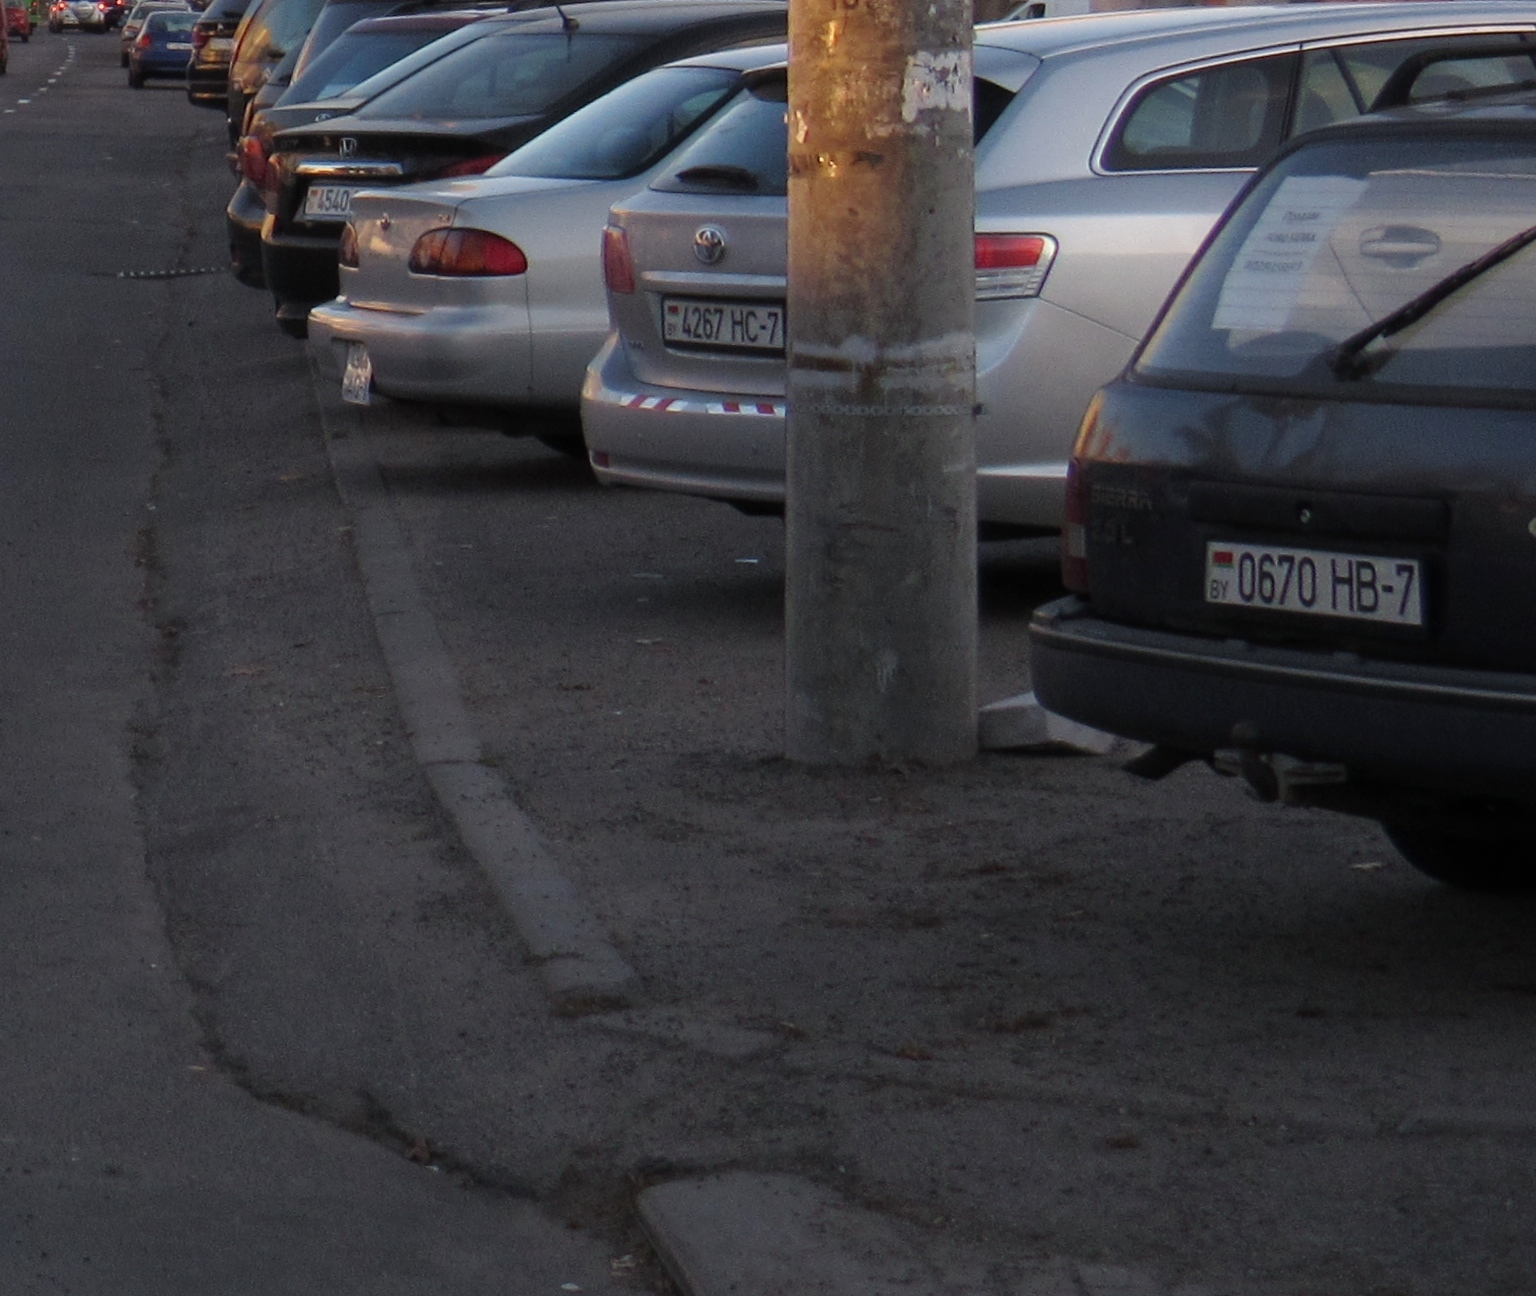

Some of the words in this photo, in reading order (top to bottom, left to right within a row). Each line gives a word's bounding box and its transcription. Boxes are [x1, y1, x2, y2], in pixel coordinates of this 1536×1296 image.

[317, 187, 350, 212] 4540
[682, 306, 723, 340] 4267
[731, 309, 779, 345] HC-7
[1209, 579, 1229, 599] BY
[1238, 551, 1317, 608] 0670
[1330, 557, 1416, 616] HB-7
